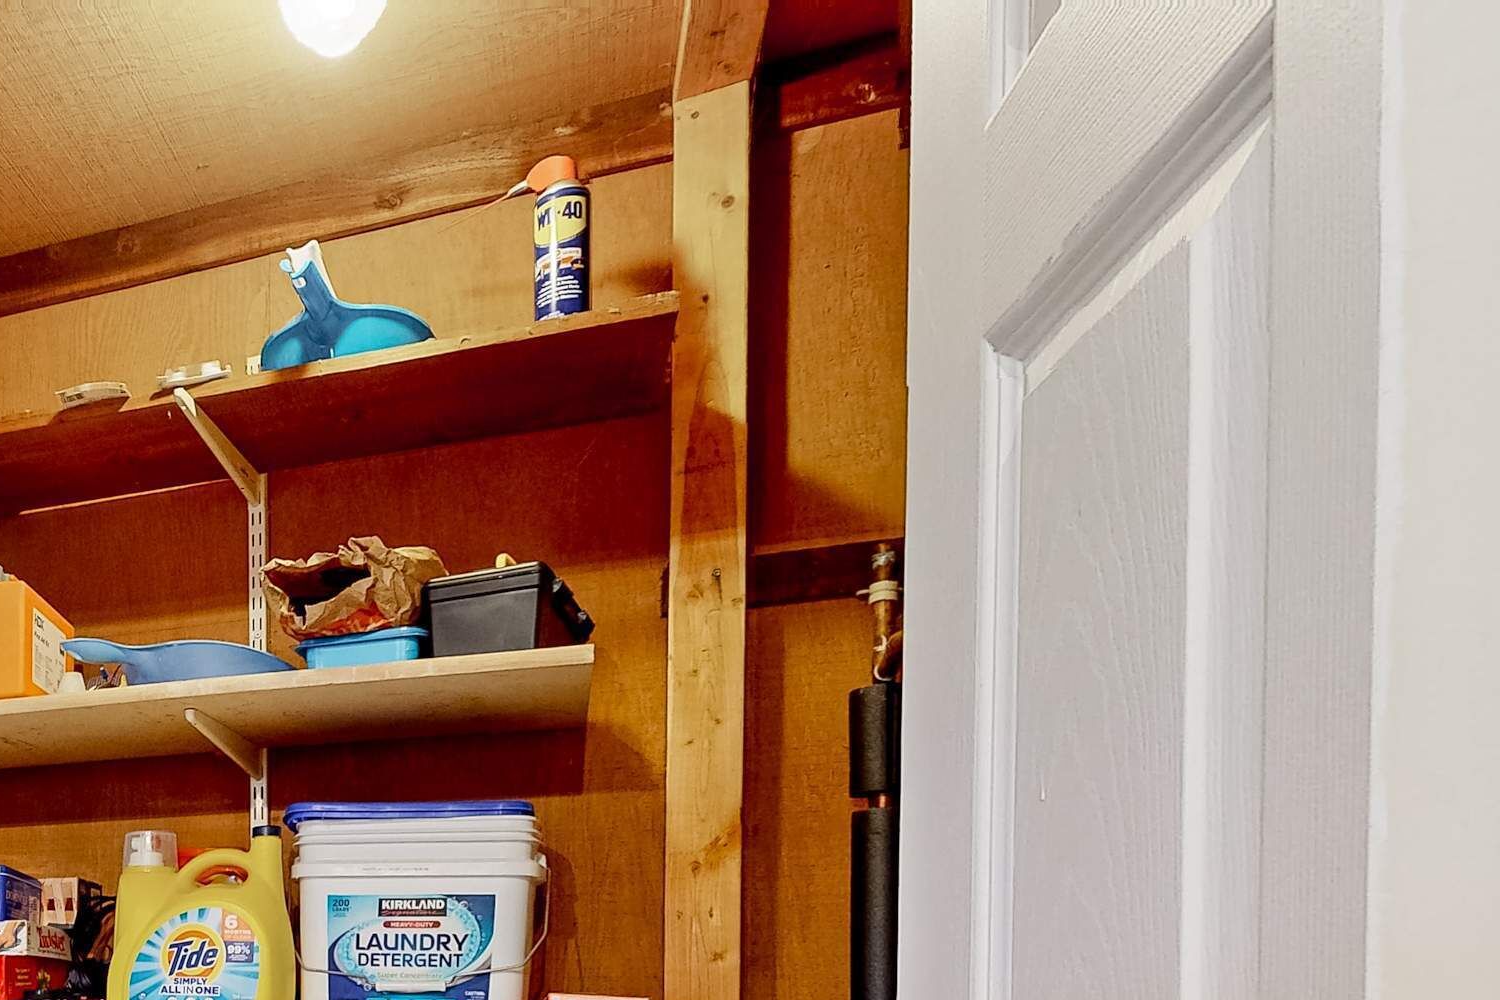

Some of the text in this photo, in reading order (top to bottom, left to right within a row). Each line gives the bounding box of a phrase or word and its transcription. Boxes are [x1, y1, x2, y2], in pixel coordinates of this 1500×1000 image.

[332, 899, 350, 907] 200
[381, 899, 446, 910] KIRKLAND
[224, 914, 239, 930] 6
[36, 926, 66, 952] Twister
[355, 932, 469, 951] LAUNDRY
[168, 940, 219, 977] Tide
[358, 953, 463, 968] DETERGENT
[174, 977, 208, 985] SIMPLY
[183, 986, 194, 994] IN
[195, 986, 219, 995] ONE
